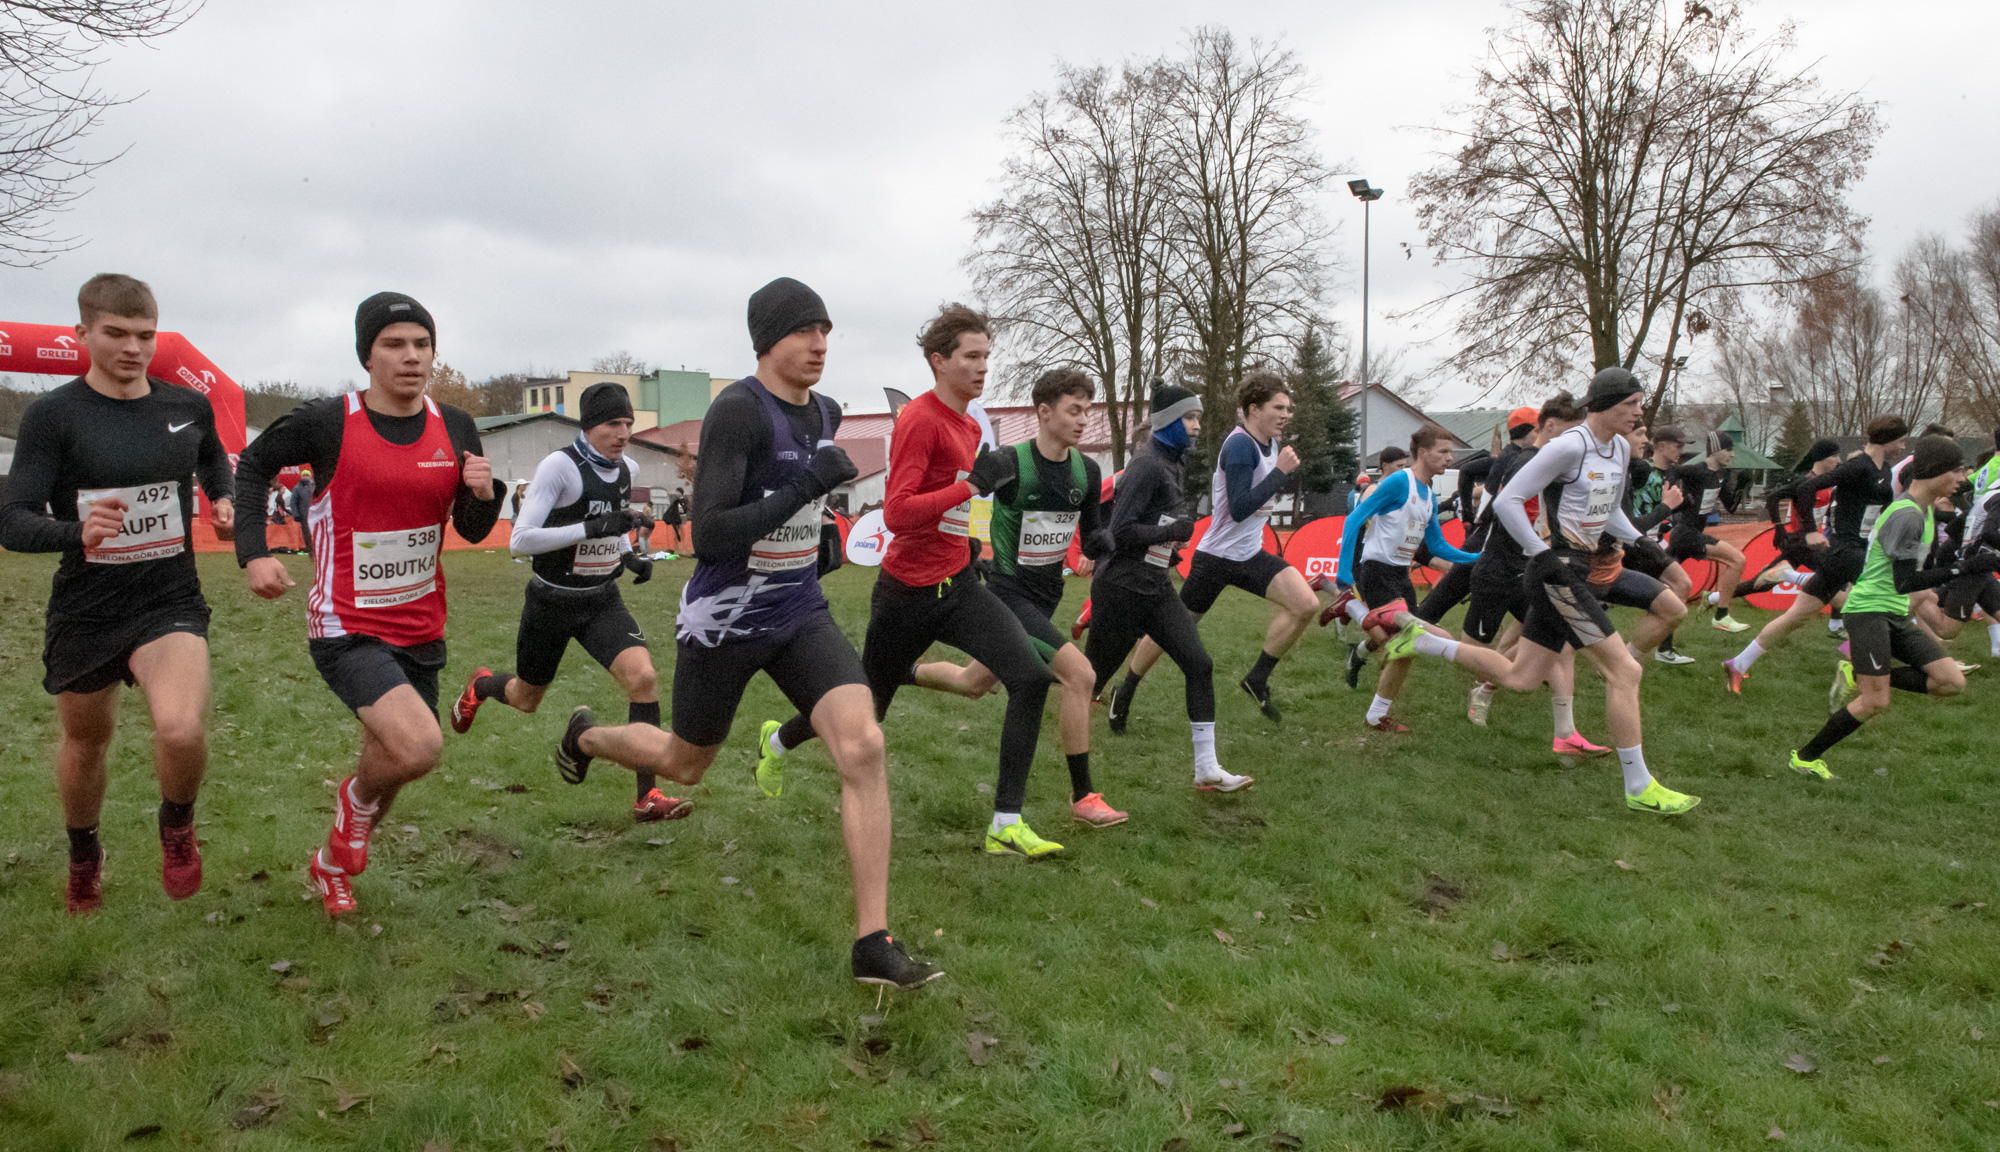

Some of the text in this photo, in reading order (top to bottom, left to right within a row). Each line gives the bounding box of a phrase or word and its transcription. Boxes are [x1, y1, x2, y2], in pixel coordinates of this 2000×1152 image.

[39, 349, 76, 359] ORLEN
[179, 368, 208, 393] ORLEN
[136, 486, 170, 504] 492
[118, 513, 169, 536] AUPT
[1054, 513, 1075, 524] 329
[407, 530, 436, 547] 538
[853, 540, 877, 549] polanik
[1023, 531, 1073, 546] BORECKI
[95, 554, 130, 562] ZIELONA
[133, 550, 159, 560] GÓRA
[358, 554, 435, 580] SOBUTKA
[363, 596, 398, 605] ZIELONA
